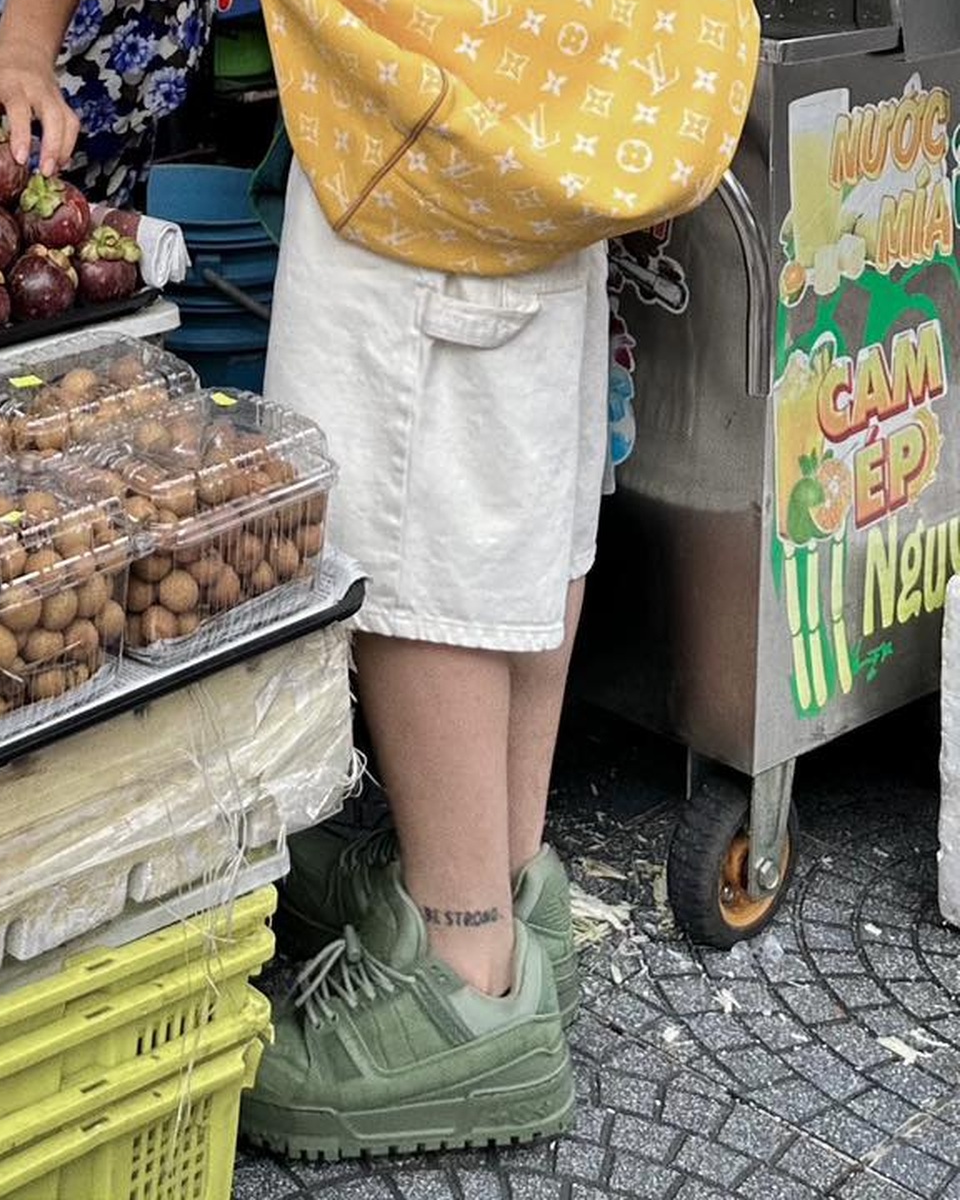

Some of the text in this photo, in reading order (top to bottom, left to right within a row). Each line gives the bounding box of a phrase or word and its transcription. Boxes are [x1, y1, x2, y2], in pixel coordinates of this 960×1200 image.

[829, 72, 951, 190] NƯỚC
[876, 164, 954, 275] MÍA
[818, 320, 947, 444] CAM
[853, 425, 928, 531] ÉP
